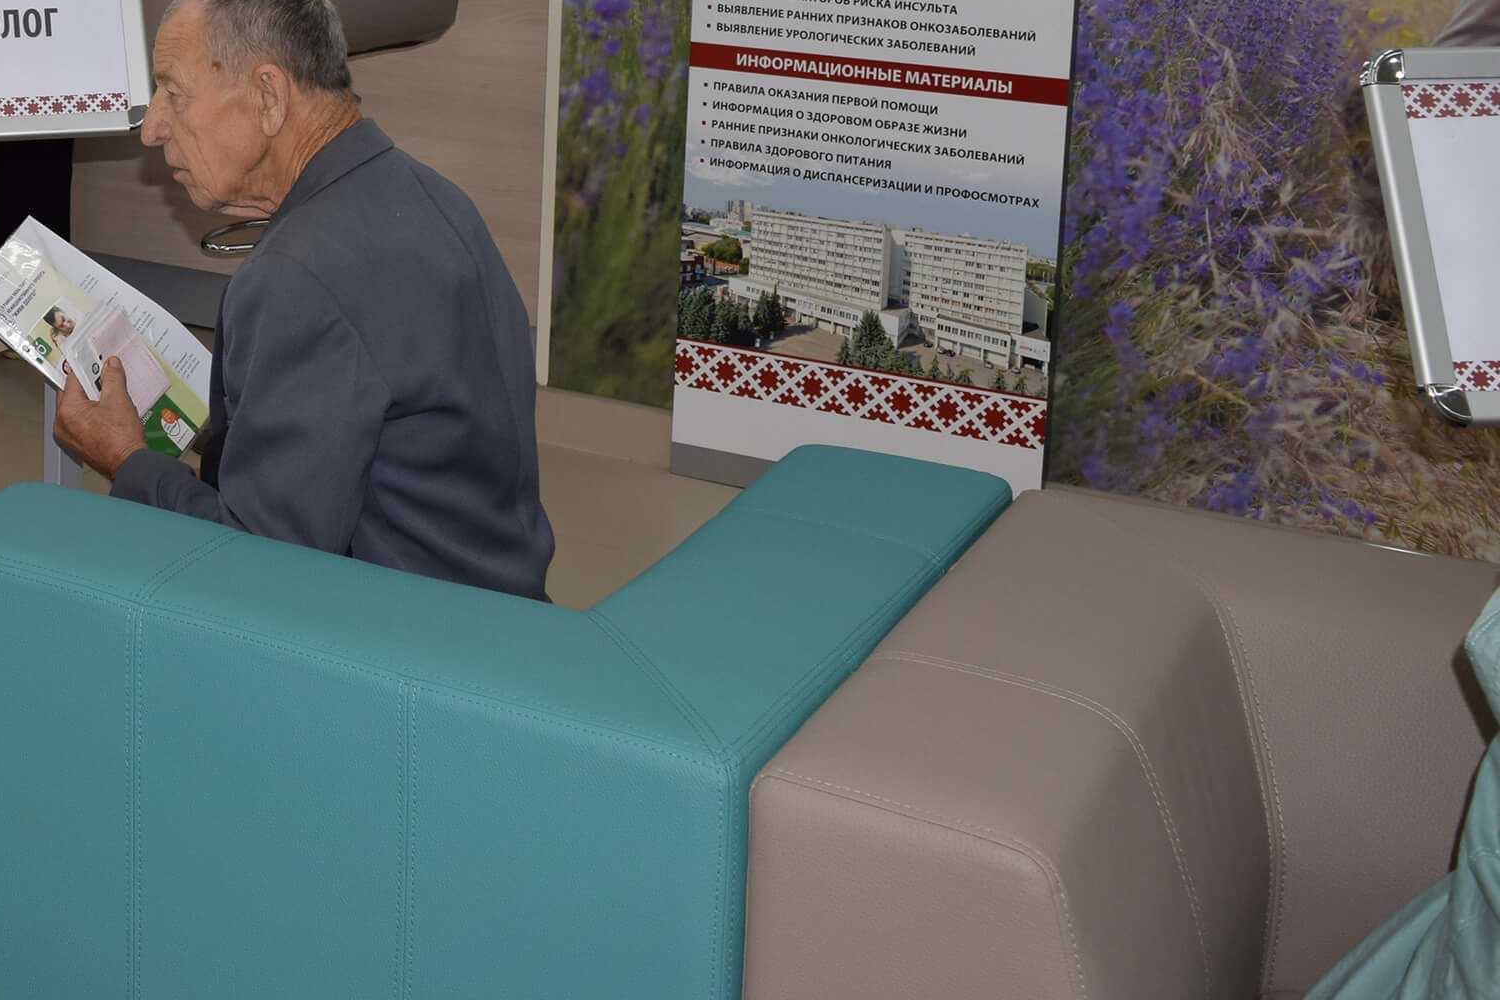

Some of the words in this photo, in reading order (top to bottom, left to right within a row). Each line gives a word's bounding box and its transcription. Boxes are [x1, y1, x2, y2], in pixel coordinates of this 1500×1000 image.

[716, 3, 785, 20] ВЫЯВЛЕНИЕ
[787, 8, 834, 24] РАННИХ
[836, 12, 908, 30] ПРИЗНАКОВ
[910, 18, 1037, 42] ОНКОЗАБОЛЕВАНИЙ
[716, 22, 783, 39] ВЫЯВЛЕНИЕ
[785, 28, 885, 48] УРОЛОГИЧЕСКИХ
[886, 36, 976, 57] ЗАБОЛЕВАНИЙ
[735, 52, 902, 84] ИНФОРМАЦИОННЫЕ
[904, 69, 1013, 95] МАТЕРИАЛЫ
[713, 81, 766, 97] ПРАВИЛА
[767, 86, 830, 104] ОКАЗАНИЯ
[831, 92, 879, 109] ПЕРВОЙ
[880, 98, 939, 116] ПОМОЩИ
[712, 100, 794, 119] ИНФОРМАЦИЯ
[795, 108, 805, 120] О
[806, 110, 872, 129] ЗДОРОВОМ
[874, 117, 921, 135] ОБРАЗЕ
[922, 123, 967, 139] ЖИЗНИ
[710, 138, 763, 154] ПРАВИЛА
[764, 143, 833, 163] ЗДОРОВОГО
[835, 153, 892, 170] ПИТАНИЯ
[711, 119, 756, 135] РАННИЕ
[758, 124, 820, 143] ПРИЗНАКИ
[821, 130, 932, 156] ОНКОЛОГИЧЕСКИХ
[933, 143, 1025, 167] ЗАБОЛЕВАНИЙ
[709, 157, 791, 178] ИНФОРМАЦИЯ
[792, 166, 802, 178] О
[803, 167, 923, 195] ДИСПАНСЕРИЗАЦИИ
[925, 183, 934, 195] И
[935, 184, 1040, 208] ПРОФОСМОТРАХ
